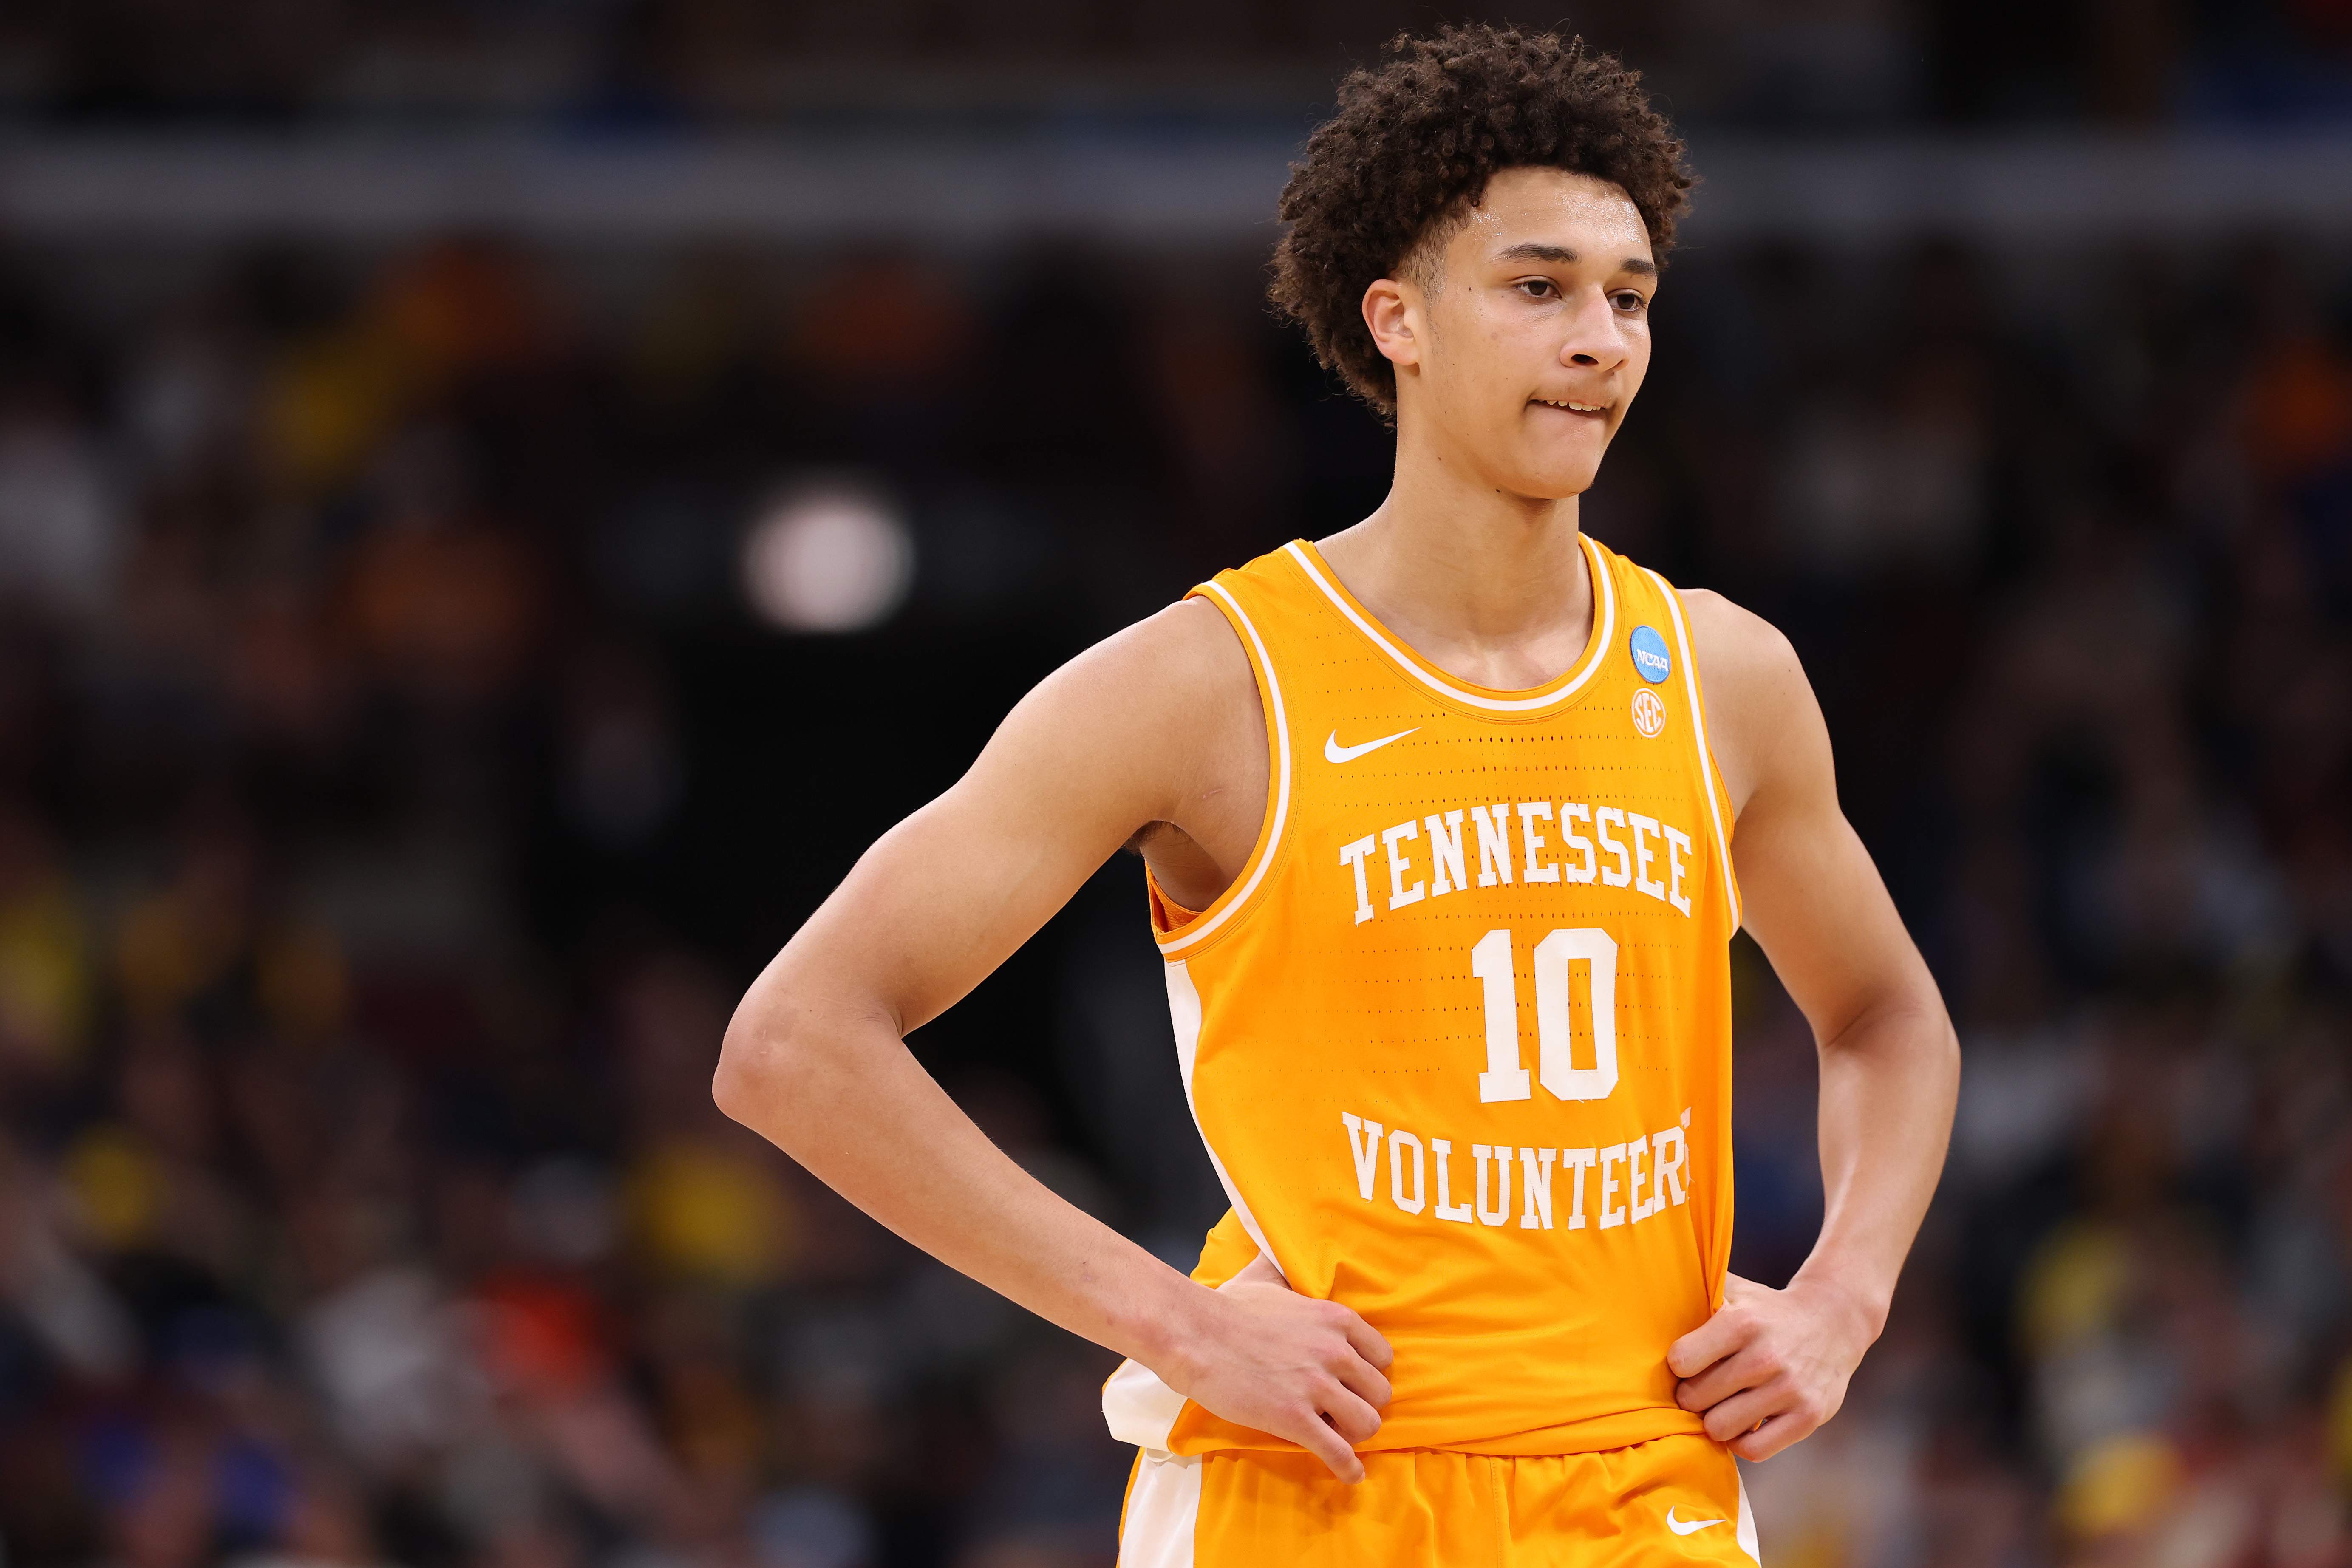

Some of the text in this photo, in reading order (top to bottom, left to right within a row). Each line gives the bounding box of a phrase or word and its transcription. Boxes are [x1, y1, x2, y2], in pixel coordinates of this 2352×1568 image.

[1637, 649, 1669, 671] NCAA
[1634, 692, 1661, 733] SEC
[1340, 802, 1693, 927] TENNESSEE
[1471, 928, 1619, 1103] 10
